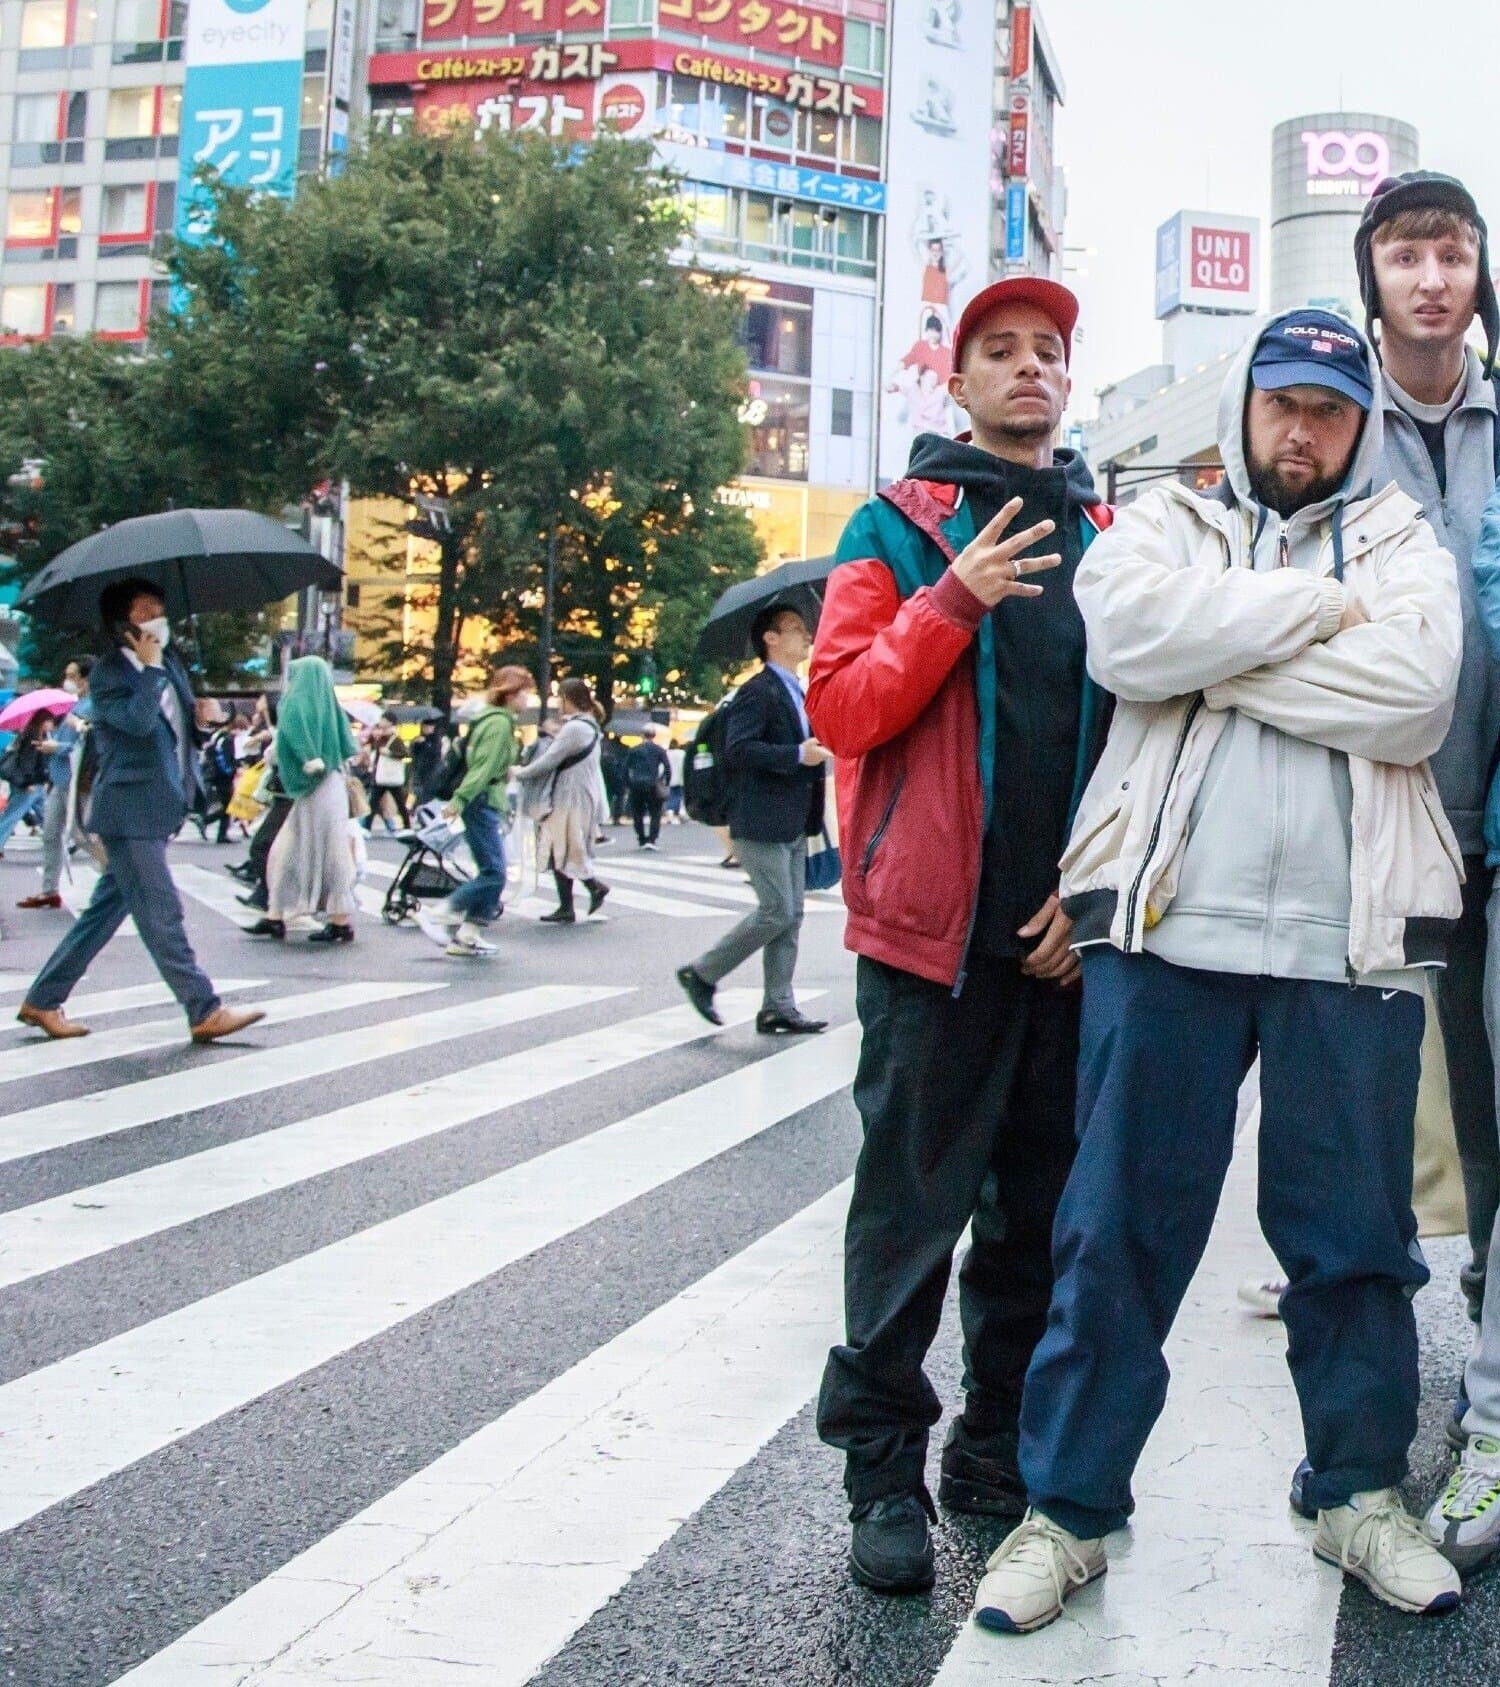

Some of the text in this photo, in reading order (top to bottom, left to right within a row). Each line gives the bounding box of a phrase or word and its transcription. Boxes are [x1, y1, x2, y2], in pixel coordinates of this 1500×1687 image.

[203, 21, 292, 47] eyecity
[660, 0, 840, 51] コンタクト
[529, 43, 618, 81] ガスト
[786, 73, 868, 115] ガスト
[1301, 131, 1391, 197] 109
[1197, 234, 1241, 260] UNI
[1196, 259, 1246, 286] QLO
[1284, 326, 1361, 349] POLO SPORT
